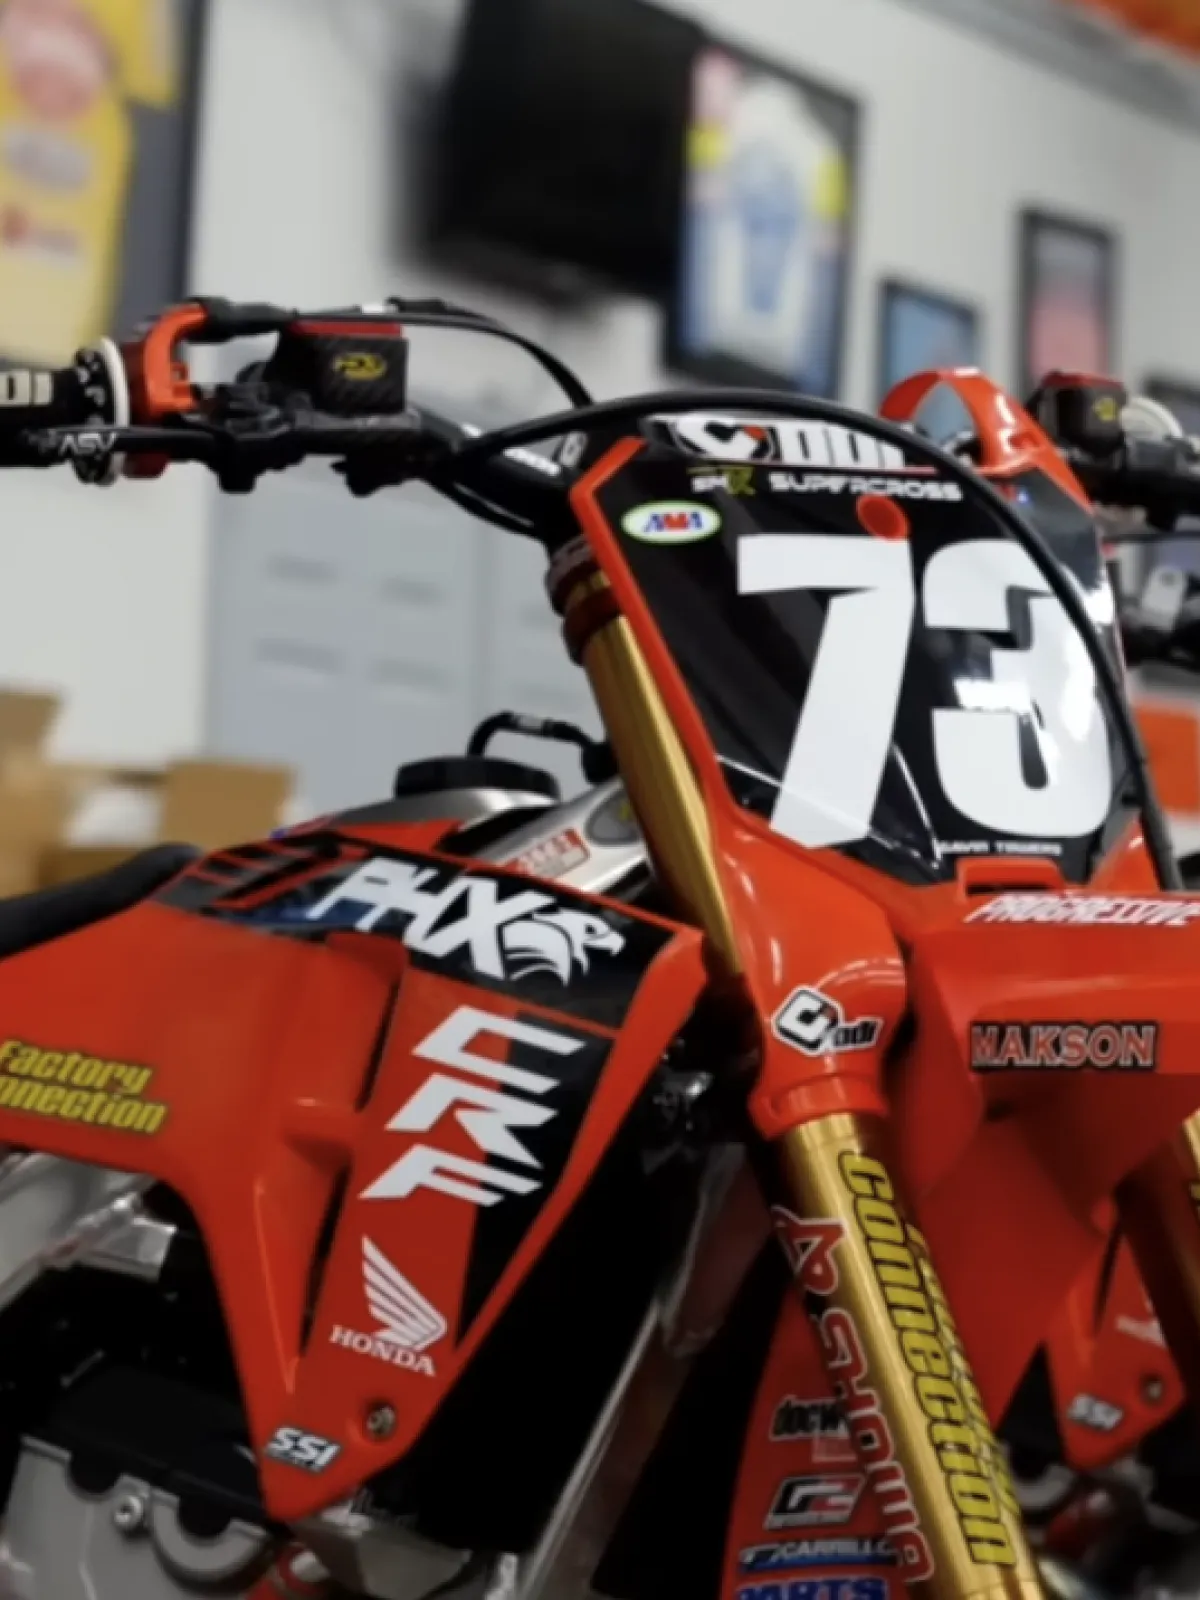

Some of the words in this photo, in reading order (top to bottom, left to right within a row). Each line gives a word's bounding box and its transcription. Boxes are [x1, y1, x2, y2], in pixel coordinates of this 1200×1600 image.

[644, 511, 703, 533] AMA
[737, 534, 1113, 850] 73
[306, 857, 557, 981] PHX
[970, 1023, 1158, 1069] MAKSON
[357, 1004, 589, 1208] CRF
[329, 1324, 437, 1378] HONDA
